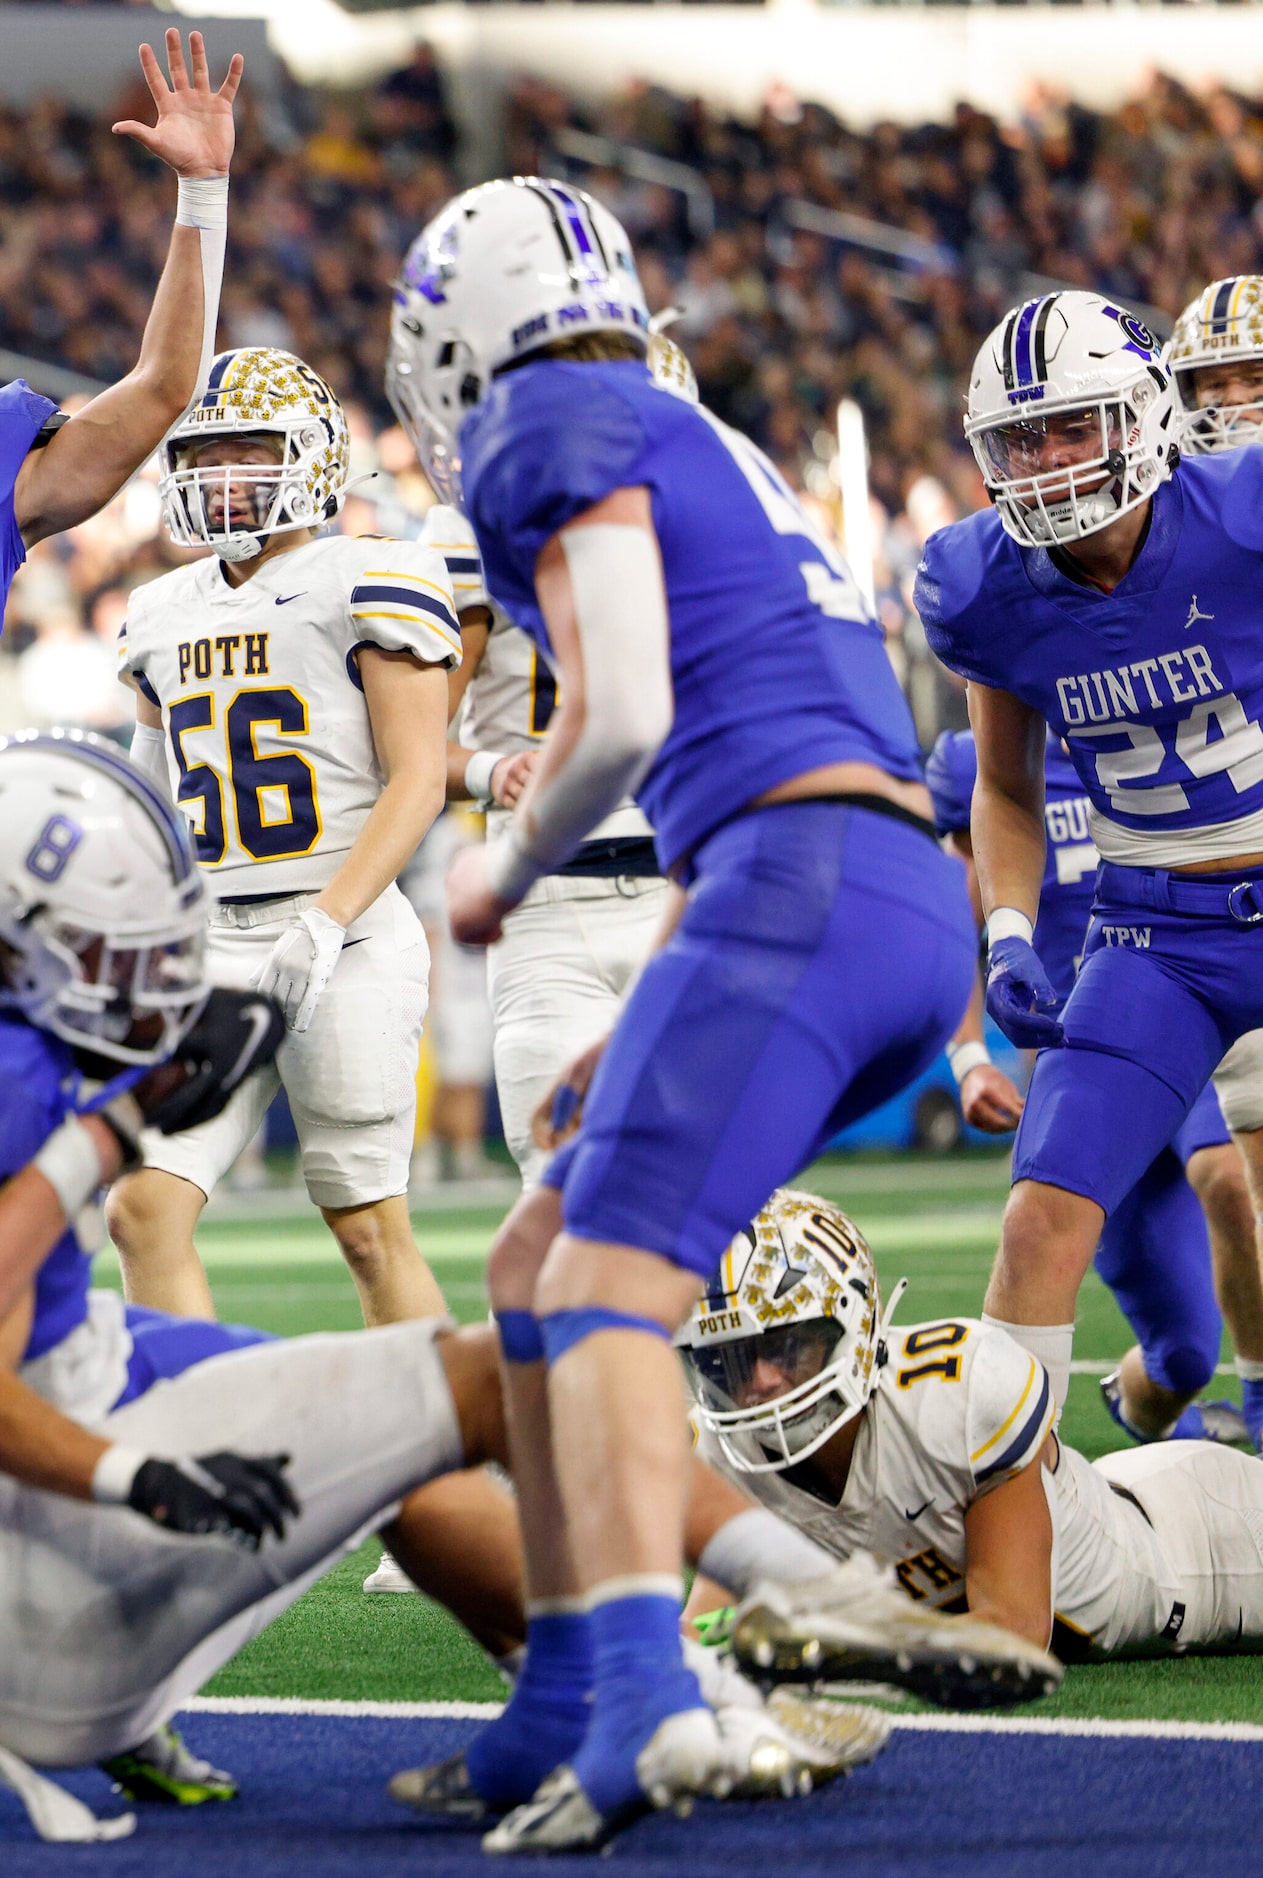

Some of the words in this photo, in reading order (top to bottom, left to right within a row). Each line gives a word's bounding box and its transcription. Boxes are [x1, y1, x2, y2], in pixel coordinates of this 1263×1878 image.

[1202, 333, 1240, 349] POTH
[1007, 384, 1045, 406] TPW
[178, 631, 271, 686] POTH
[1055, 644, 1224, 725] GUNTER
[167, 685, 324, 867] 56
[1066, 691, 1263, 816] 24
[24, 813, 86, 885] 8
[1102, 925, 1151, 948] TPW
[802, 1213, 858, 1275] 10
[698, 1311, 742, 1336] POTH
[896, 1321, 972, 1390] 10
[895, 1546, 964, 1602] TH
